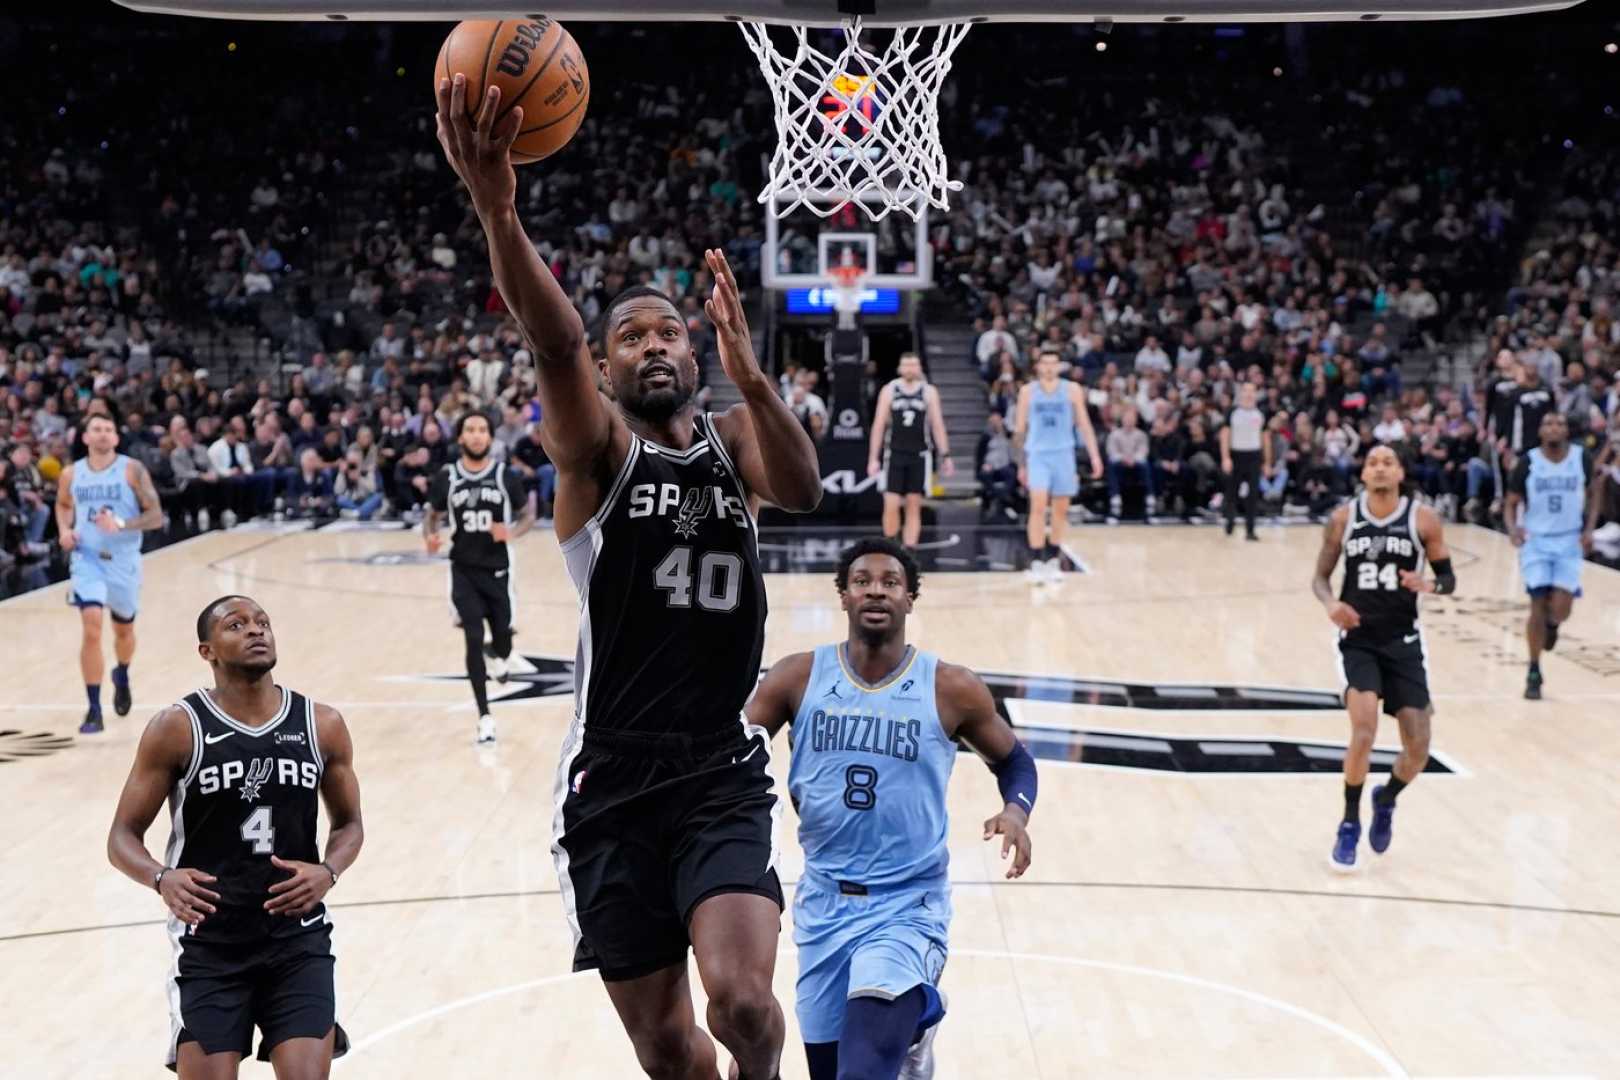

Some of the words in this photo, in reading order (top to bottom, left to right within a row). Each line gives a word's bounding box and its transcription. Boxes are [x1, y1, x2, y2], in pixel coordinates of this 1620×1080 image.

[496, 18, 554, 77] Wilso
[462, 510, 493, 533] 30
[1346, 536, 1413, 559] SPURS
[651, 544, 745, 614] 40
[1357, 562, 1399, 591] 24
[811, 709, 921, 762] GRIZZLIES
[198, 757, 319, 800] SPURS
[843, 764, 878, 811] 8
[240, 805, 275, 854] 4
